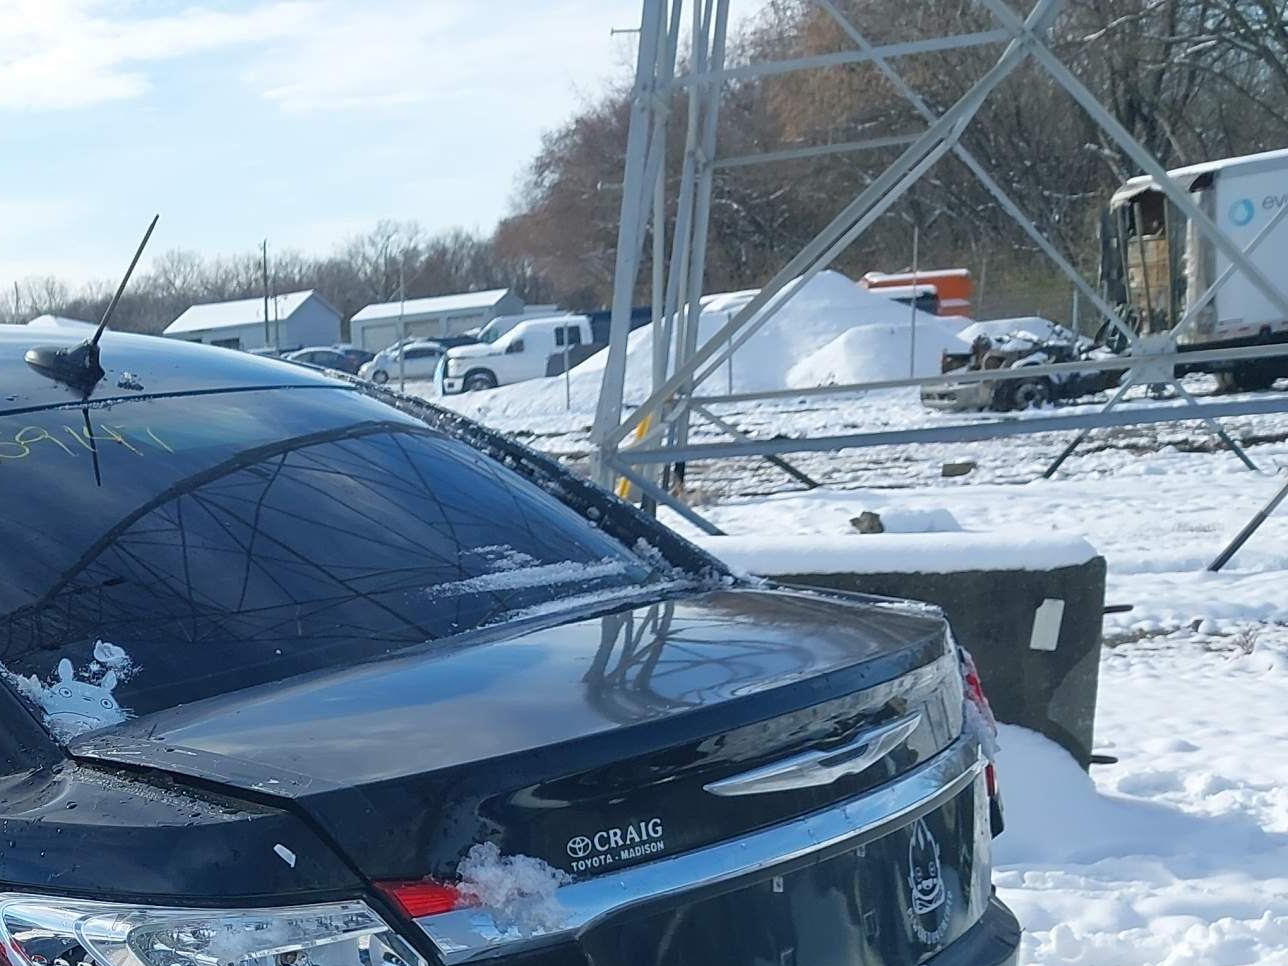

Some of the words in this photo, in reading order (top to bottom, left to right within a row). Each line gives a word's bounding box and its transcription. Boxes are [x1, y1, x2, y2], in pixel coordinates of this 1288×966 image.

[593, 818, 663, 851] CRAIG
[571, 855, 613, 872] TOYOTA
[620, 841, 665, 861] MADISON
